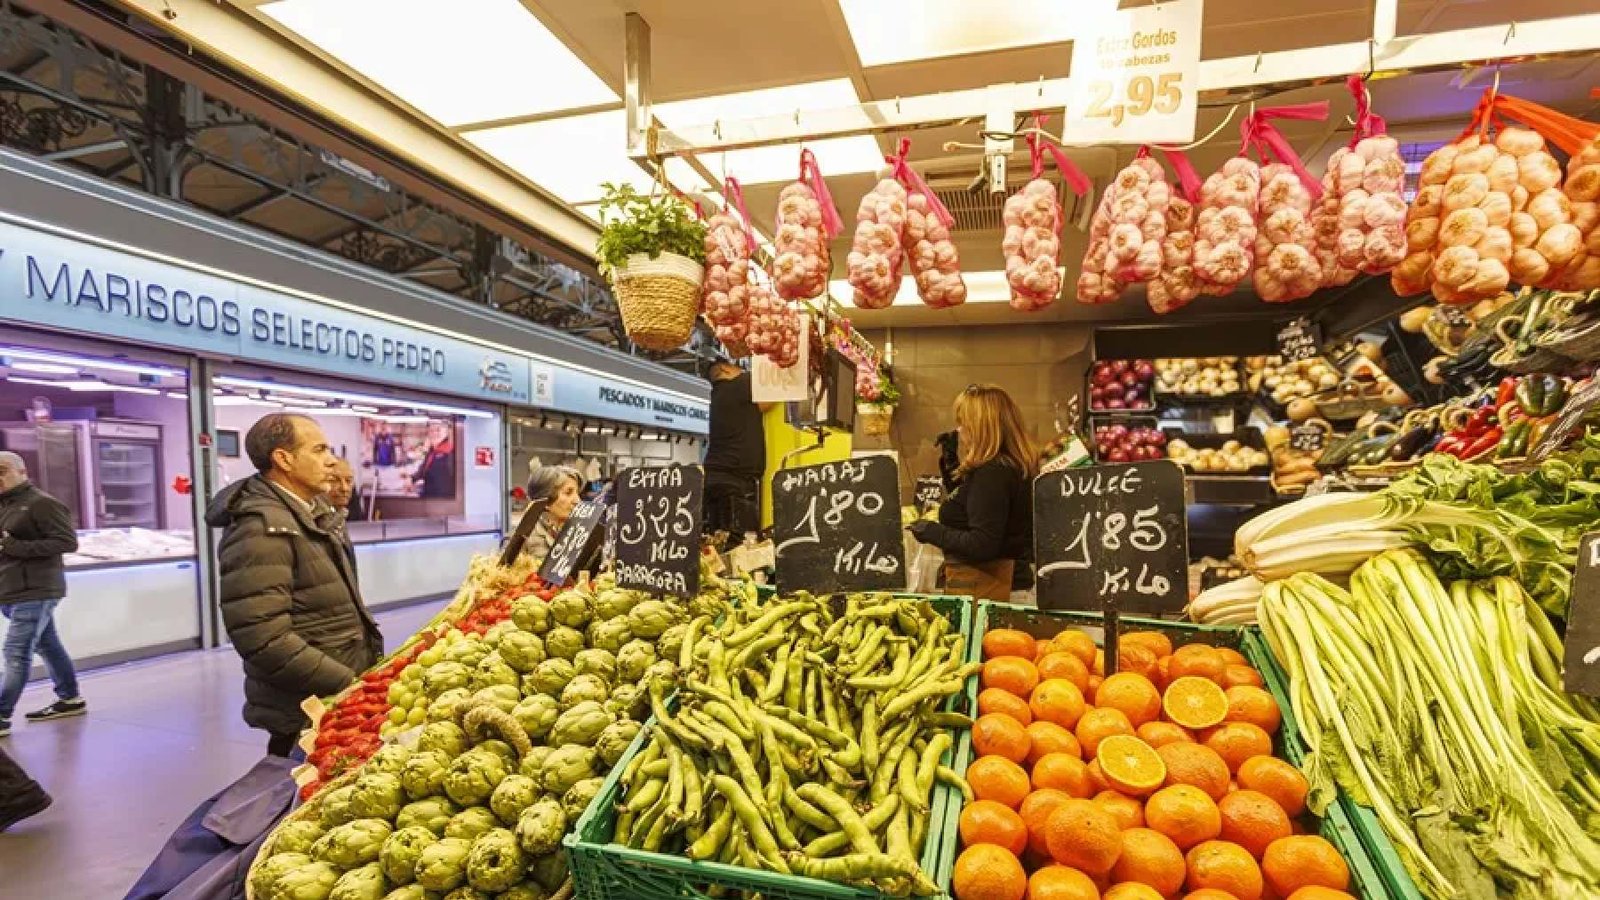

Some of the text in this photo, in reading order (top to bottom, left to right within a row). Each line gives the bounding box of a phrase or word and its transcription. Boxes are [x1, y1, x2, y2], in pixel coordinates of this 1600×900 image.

[1132, 28, 1177, 50] Gordos
[1083, 72, 1183, 128] 2,95
[26, 255, 241, 336] MARISCOS
[251, 307, 375, 362] SELECTOS
[382, 338, 445, 376] PEDRO
[599, 386, 645, 409] PESCADOS
[653, 399, 687, 416] MARISCOS
[628, 467, 682, 488] EXTRA
[781, 459, 873, 492] HABAS
[1060, 467, 1142, 497] DULCE
[620, 490, 694, 545] 3'25
